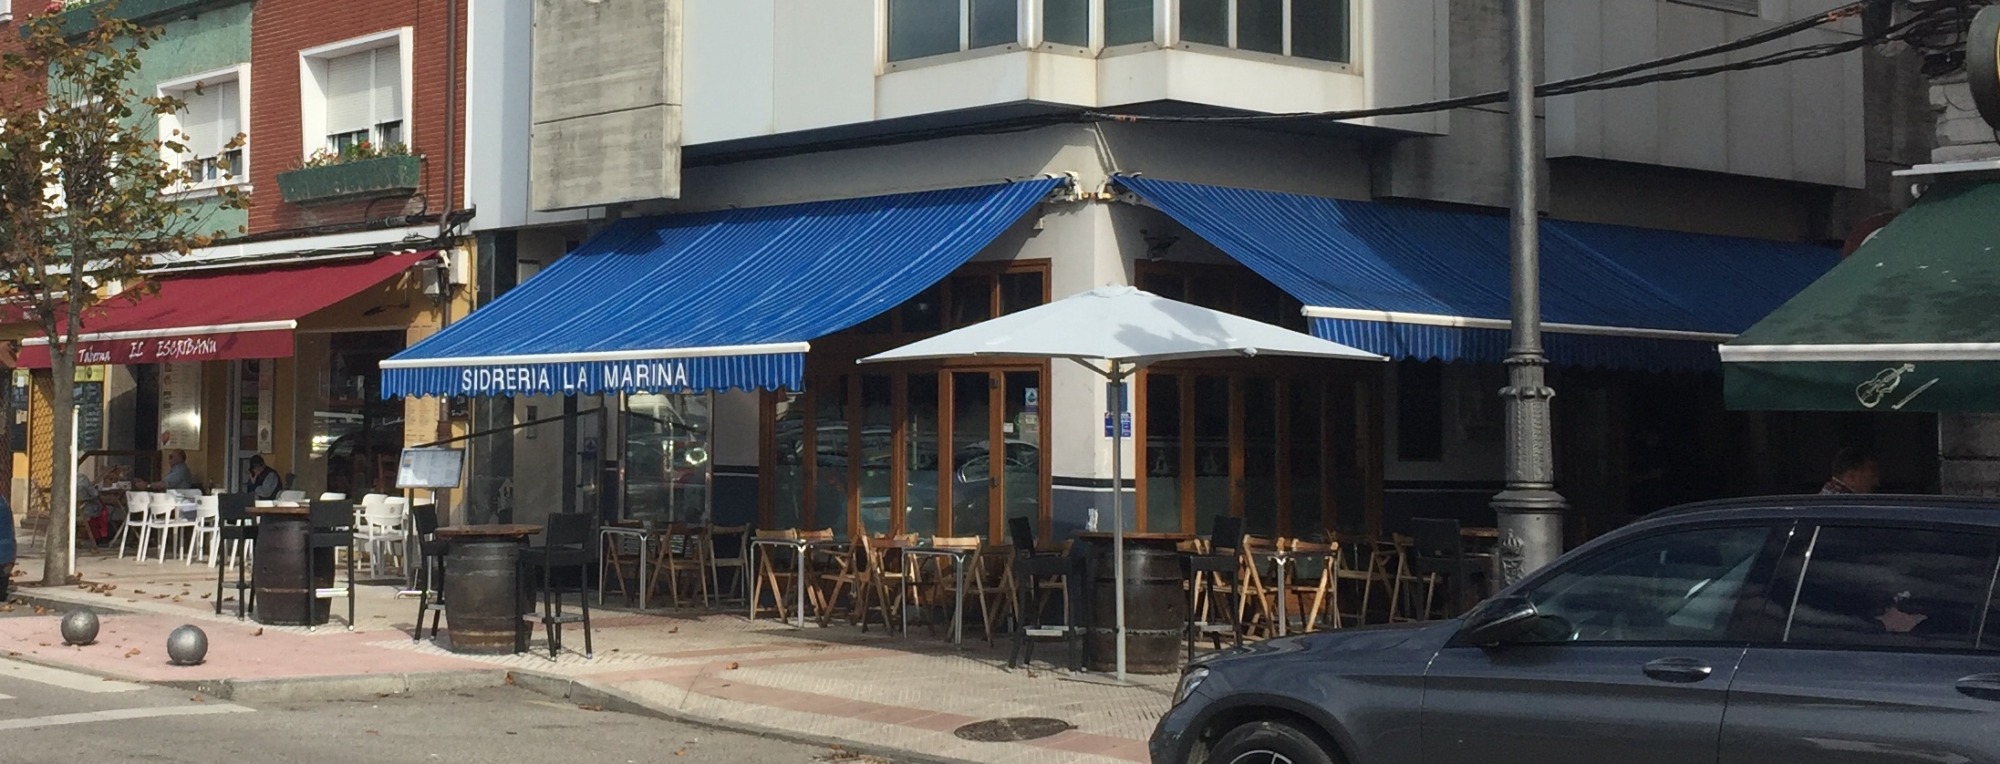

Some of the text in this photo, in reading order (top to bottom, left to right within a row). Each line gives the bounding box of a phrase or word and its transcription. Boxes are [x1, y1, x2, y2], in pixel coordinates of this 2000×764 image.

[78, 345, 111, 363] Taberna
[128, 341, 144, 359] EL
[461, 362, 687, 391] SIDRERIA LA MARINA
